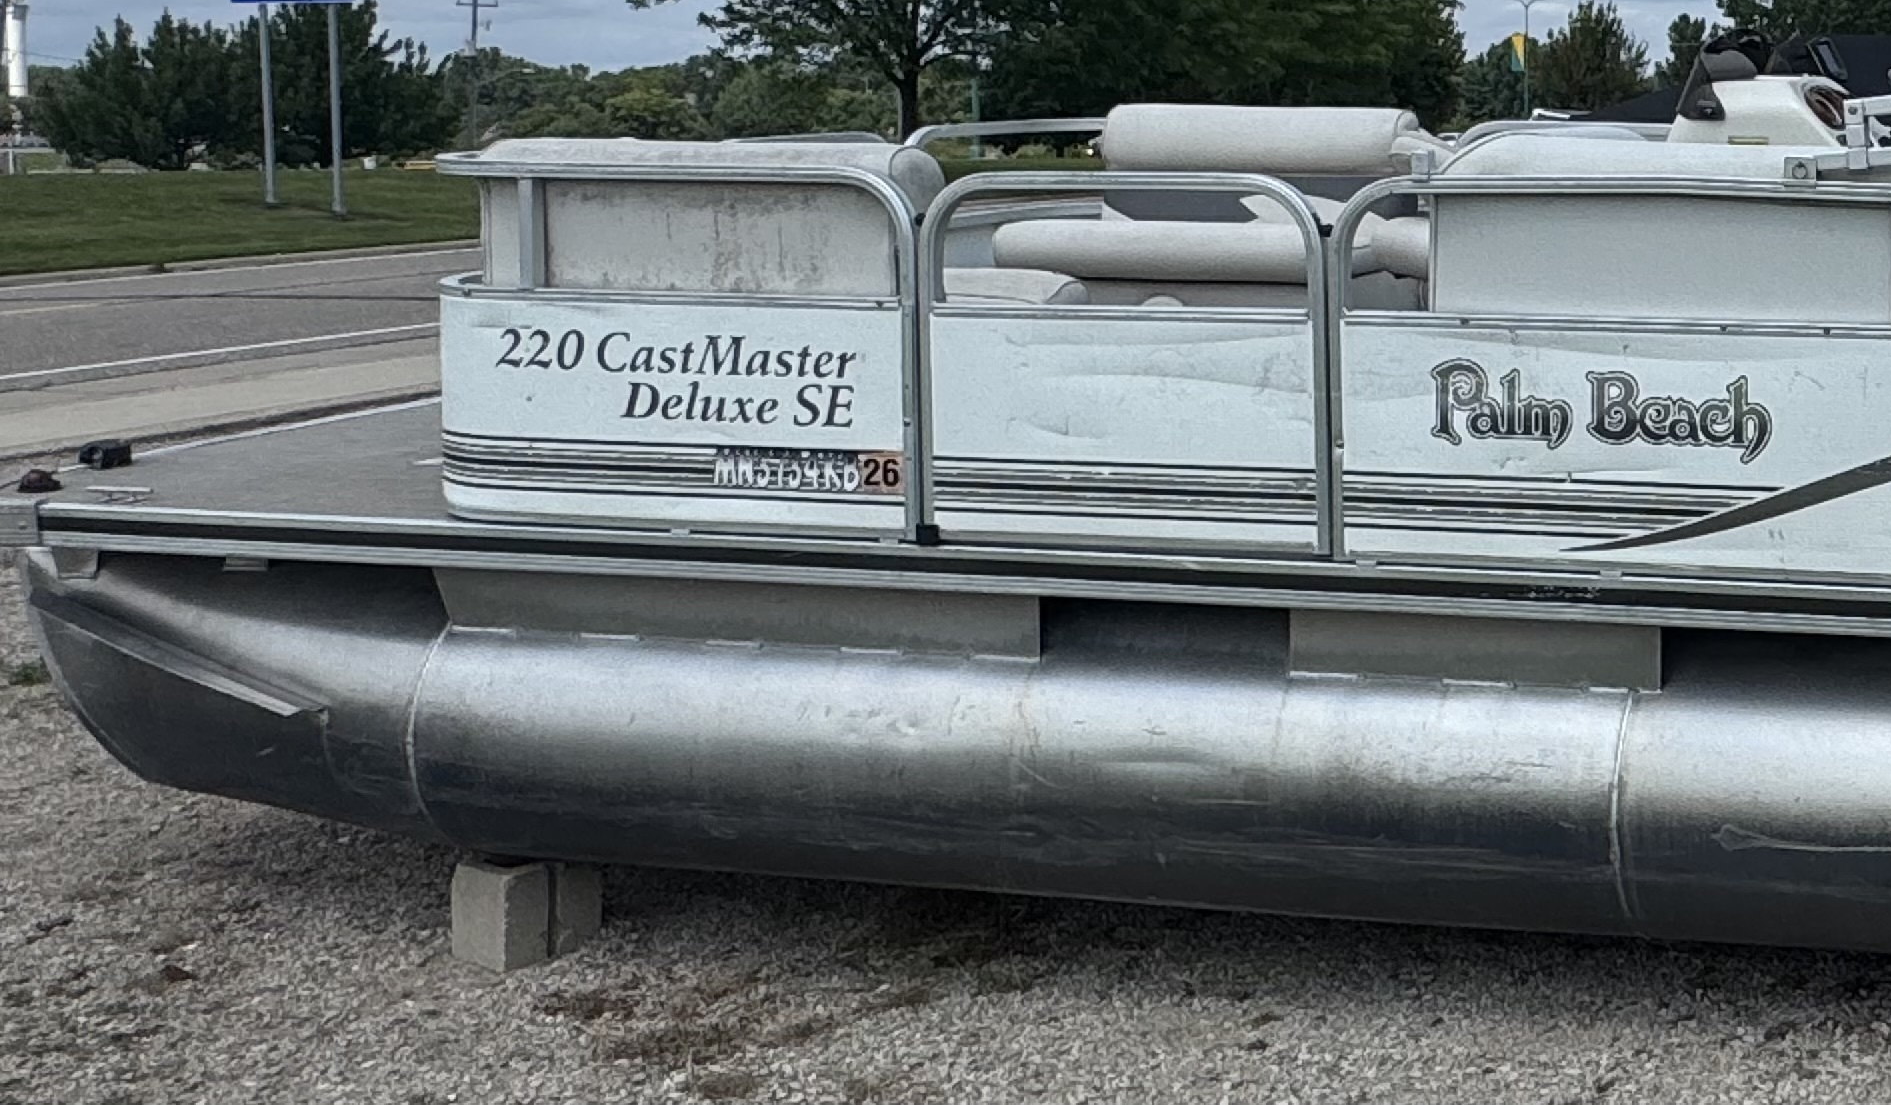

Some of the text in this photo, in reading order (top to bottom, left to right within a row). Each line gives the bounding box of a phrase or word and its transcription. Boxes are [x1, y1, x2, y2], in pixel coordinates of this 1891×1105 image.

[495, 328, 857, 379] 220 CastMaster
[621, 381, 855, 428] Deluxe SE
[1430, 357, 1773, 465] Palm Beach
[863, 458, 900, 487] 26
